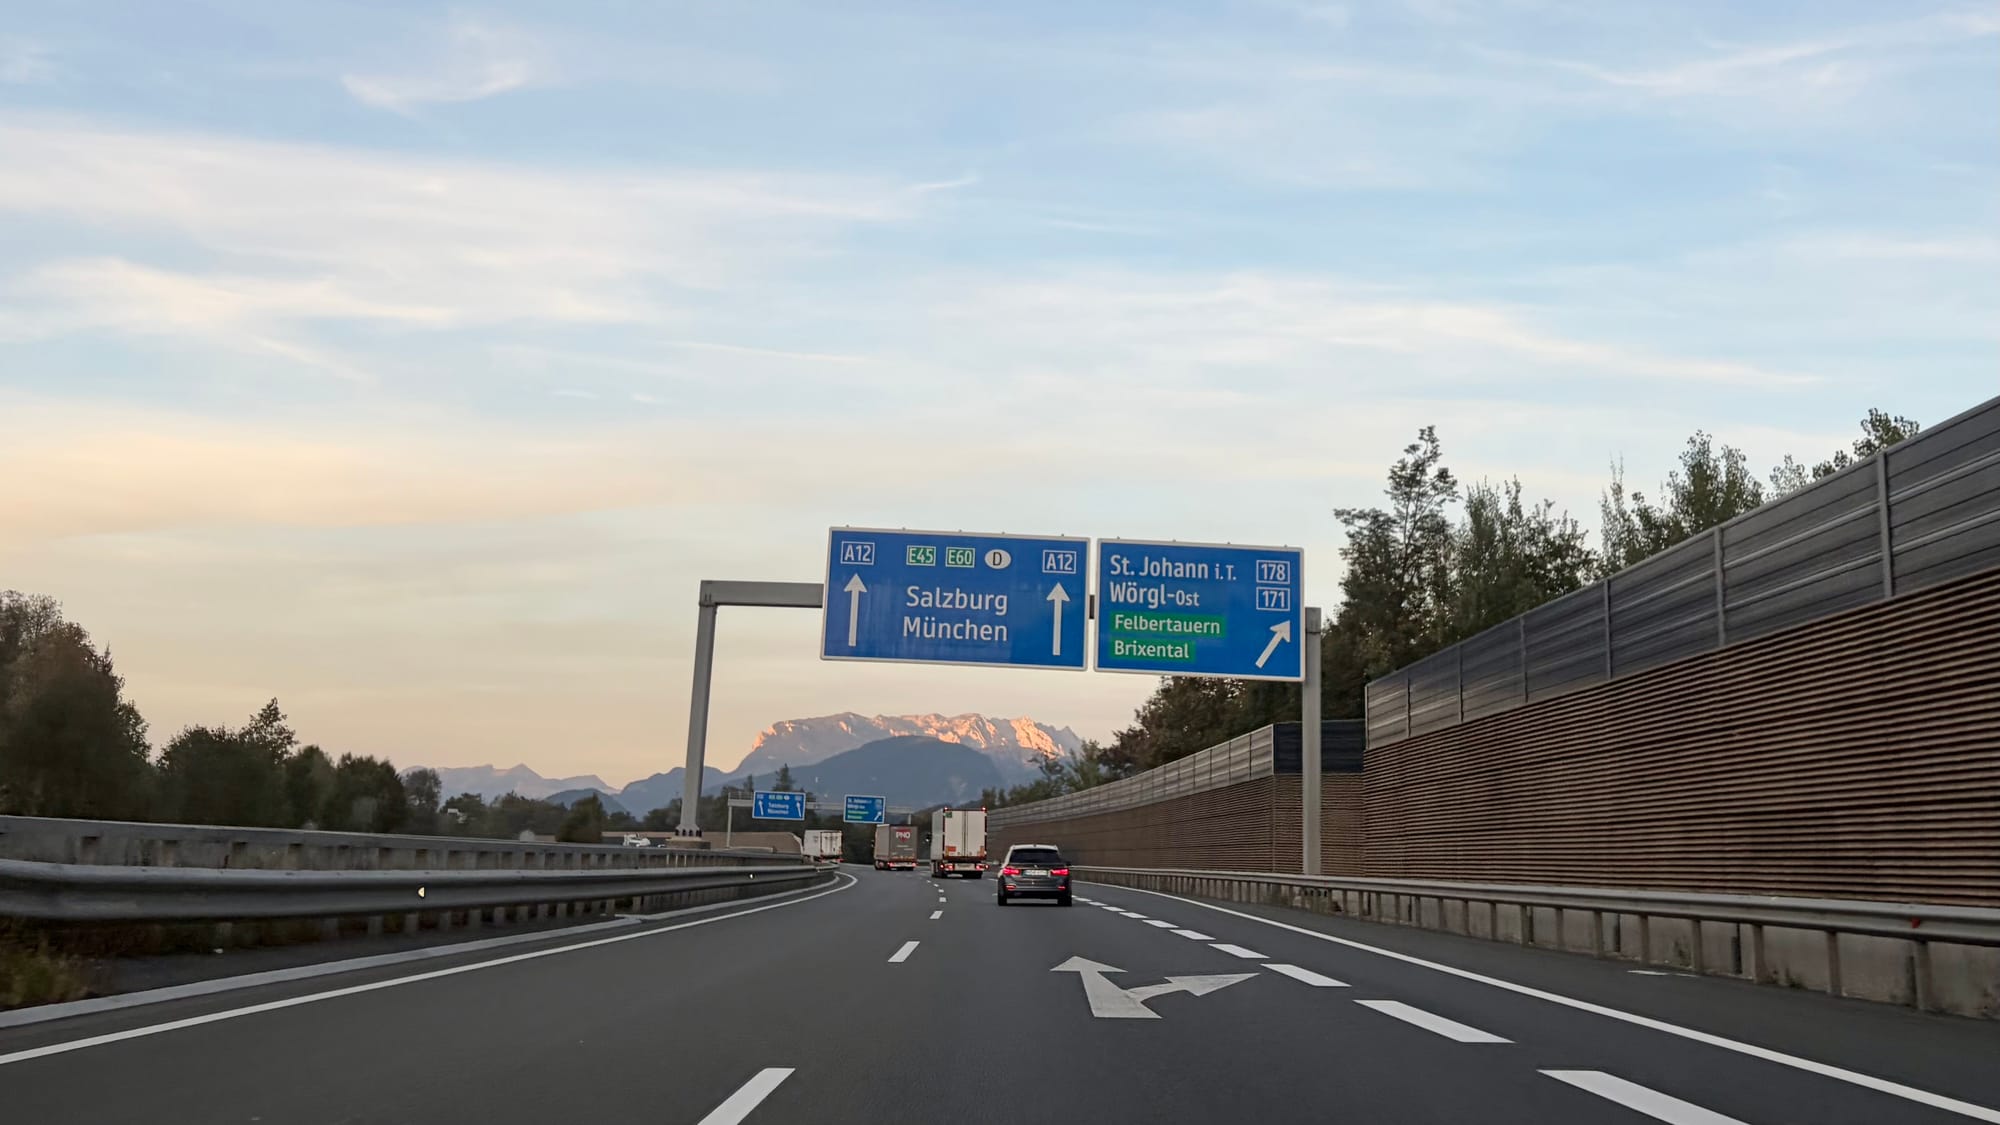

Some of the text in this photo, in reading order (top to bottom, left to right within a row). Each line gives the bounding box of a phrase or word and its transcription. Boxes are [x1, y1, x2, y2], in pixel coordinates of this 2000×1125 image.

[844, 544, 872, 562] A12
[908, 548, 1003, 567] E45 E60 D
[1046, 553, 1073, 571] A12
[1110, 554, 1135, 576] St.
[1138, 556, 1209, 579] Johann
[1261, 563, 1286, 581] 178
[905, 585, 1008, 616] Salzburg
[1110, 581, 1200, 609] Wörgl-Ost
[1262, 590, 1285, 608] 171
[902, 616, 1008, 642] München
[1115, 614, 1221, 635] Felbertauern
[1114, 640, 1190, 659] Brixental
